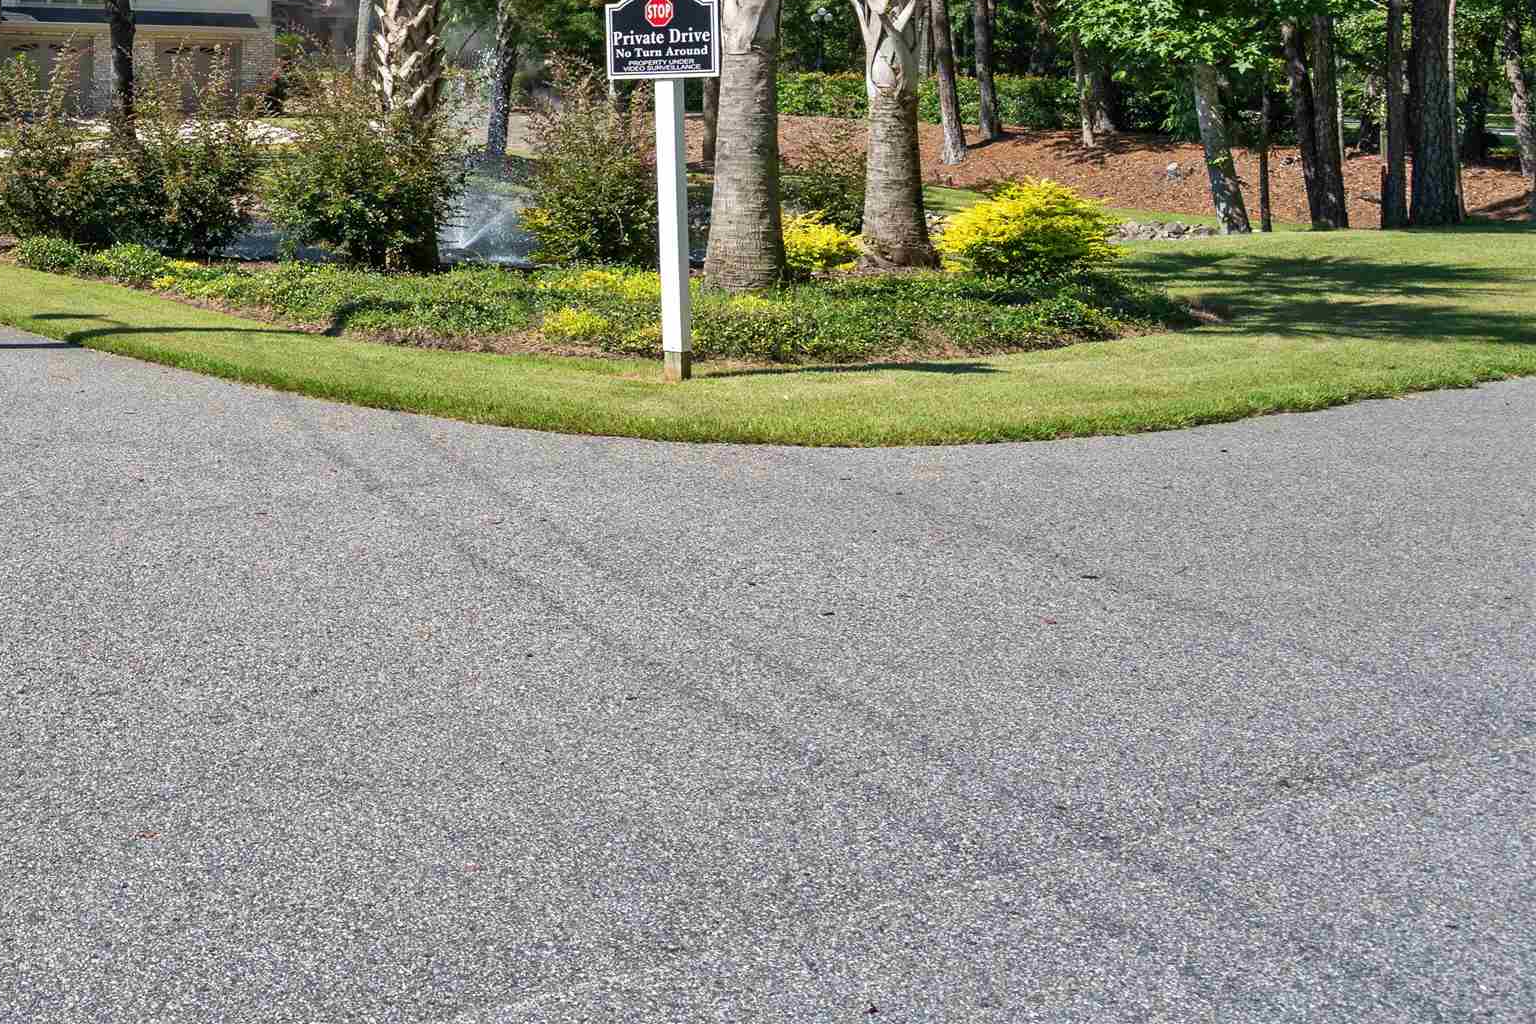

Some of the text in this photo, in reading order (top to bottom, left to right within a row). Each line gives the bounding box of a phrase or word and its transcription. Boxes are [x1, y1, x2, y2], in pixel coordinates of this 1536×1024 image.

[647, 4, 671, 19] STOP
[613, 27, 710, 46] Private Drive
[615, 45, 708, 58] No Turn Around
[623, 63, 701, 72] VIDEO SURVEILLANCE
[628, 57, 695, 66] PROPERTY UNDER
